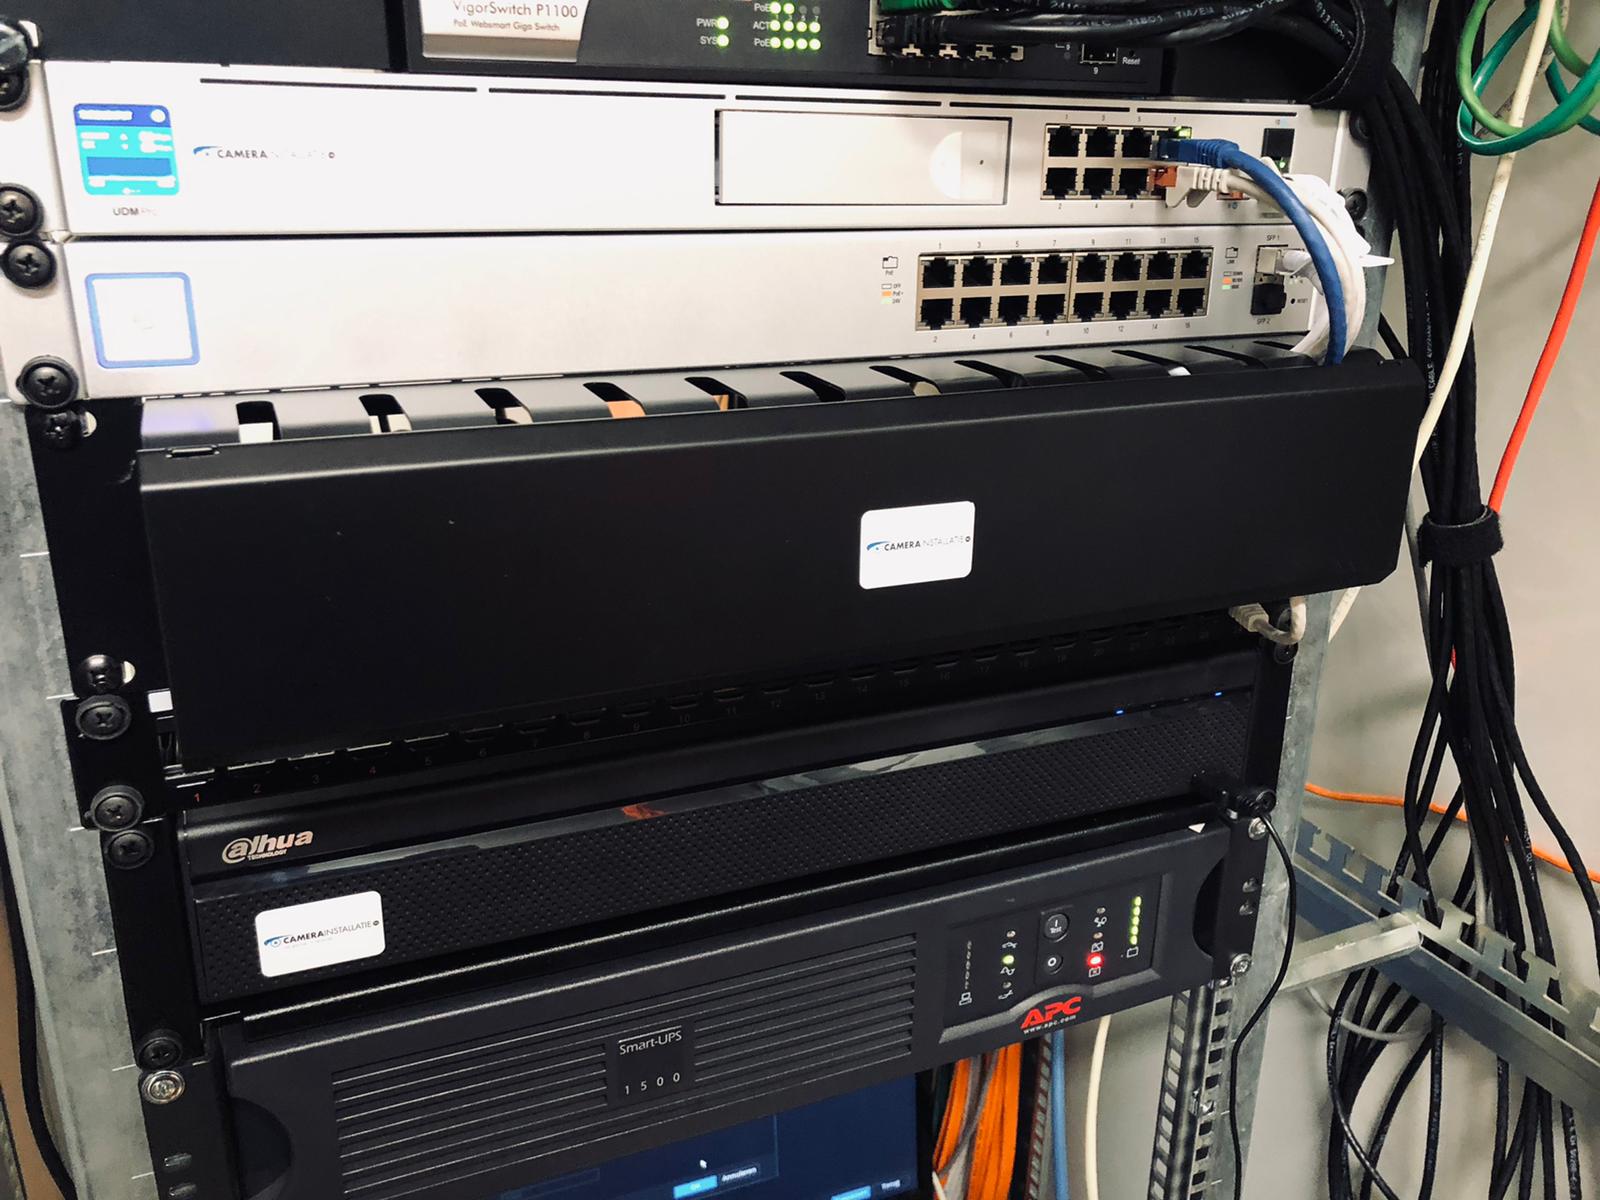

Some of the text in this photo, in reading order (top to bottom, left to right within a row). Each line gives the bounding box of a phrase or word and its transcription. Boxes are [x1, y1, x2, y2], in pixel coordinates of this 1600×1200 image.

[453, 0, 578, 18] VigorSwitch P1100
[470, 20, 511, 30] Websmart
[513, 21, 533, 32] Giga
[535, 23, 561, 31] Switch
[696, 18, 718, 27] PWR
[753, 21, 771, 30] ACT
[1122, 57, 1141, 65] Reset
[1021, 996, 1082, 1029] APC
[1023, 1014, 1077, 1034] www.apc.com
[619, 1030, 682, 1055] Smart-UPS
